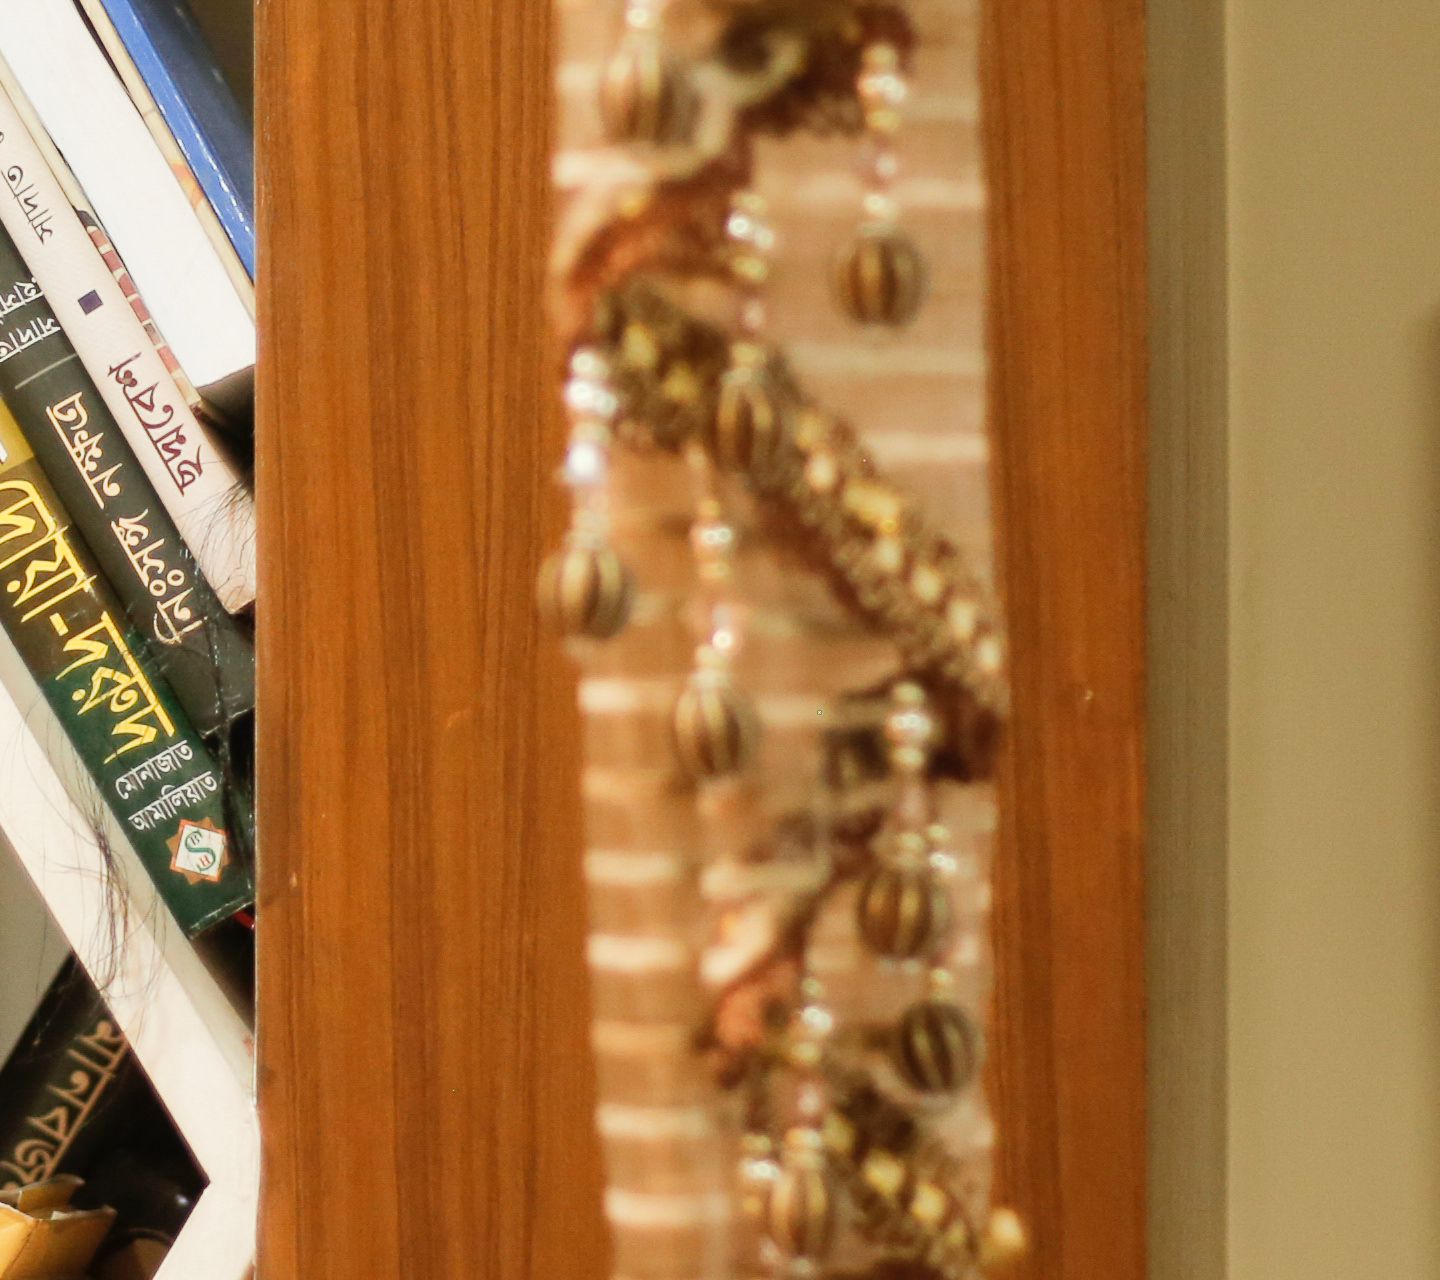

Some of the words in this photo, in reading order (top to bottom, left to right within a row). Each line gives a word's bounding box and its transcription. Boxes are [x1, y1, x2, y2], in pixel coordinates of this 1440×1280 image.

[1, 166, 52, 244] সাদাত
[46, 392, 122, 509] নক্ষত্র
[108, 353, 203, 496] ছদ্মবেশ
[111, 509, 202, 644] নিঃসঙ্গ
[116, 740, 192, 798] মোনাজাত
[128, 771, 217, 830] আমালিয়াত
